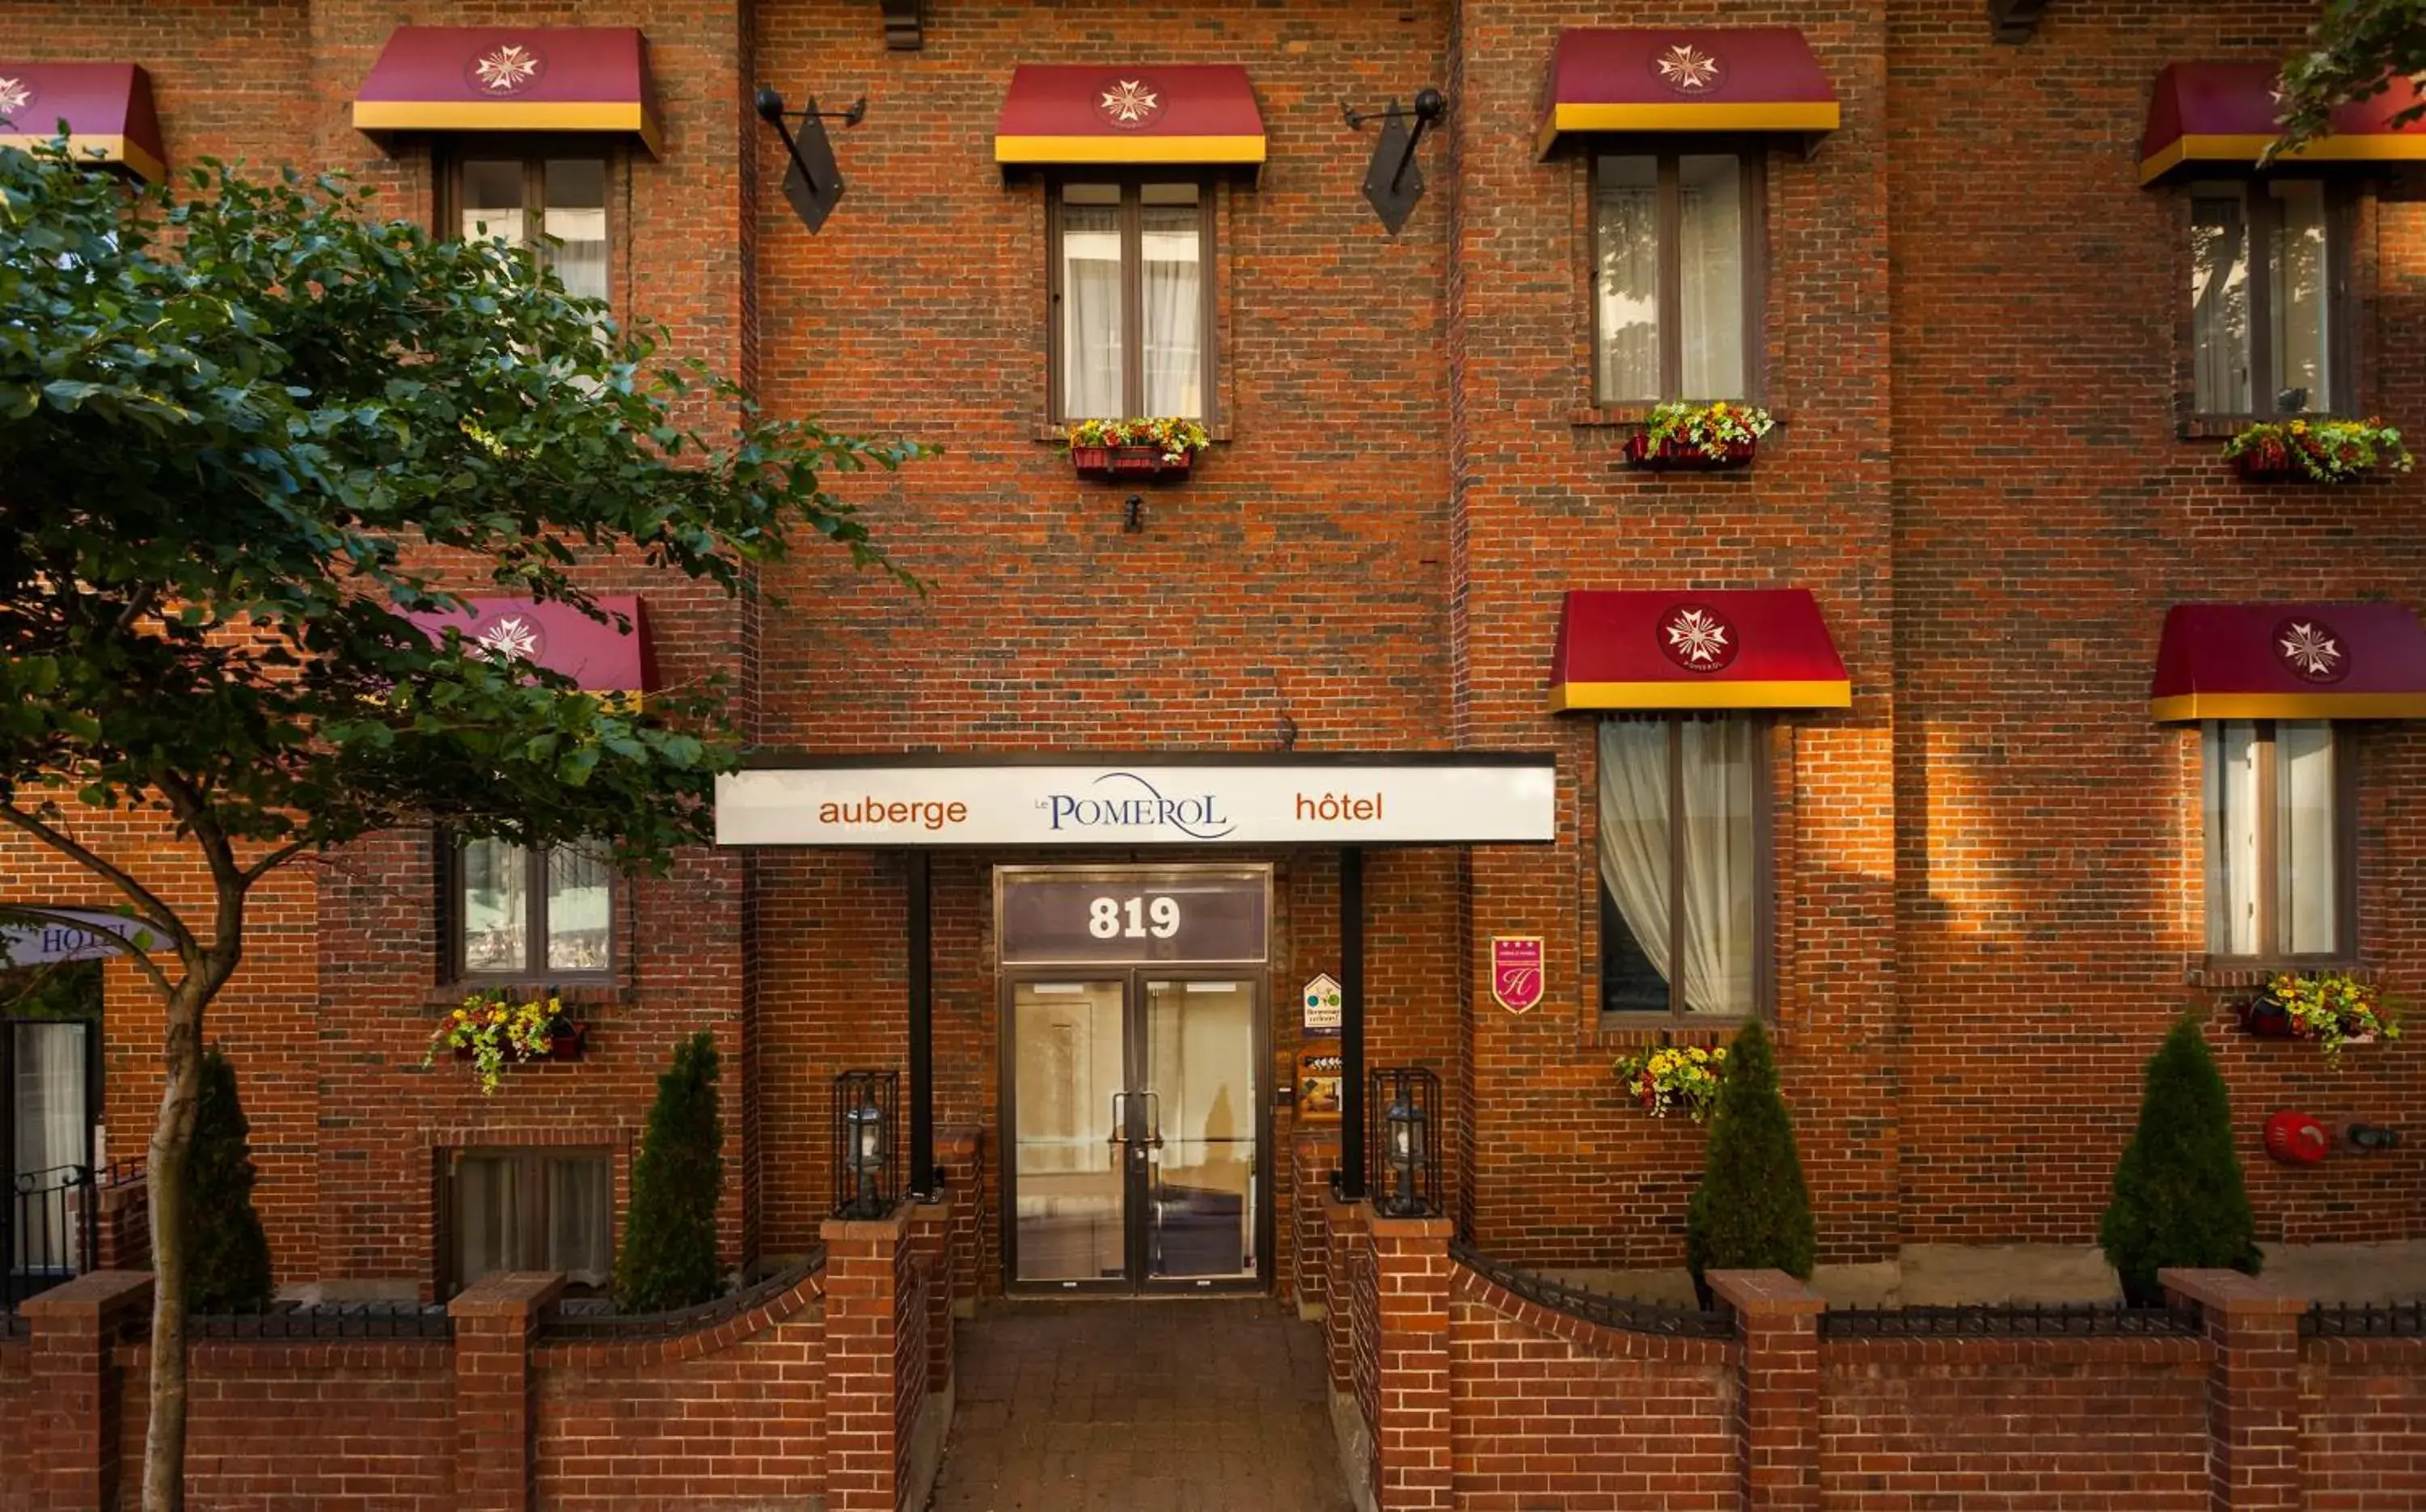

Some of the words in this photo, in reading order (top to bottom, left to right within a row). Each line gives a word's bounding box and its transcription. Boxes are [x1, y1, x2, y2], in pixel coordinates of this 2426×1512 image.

[819, 796, 968, 830] auberge
[1034, 799, 1049, 809] Le
[1048, 795, 1229, 833] POMEROL
[1296, 792, 1382, 821] hôtel
[1089, 897, 1181, 939] 819
